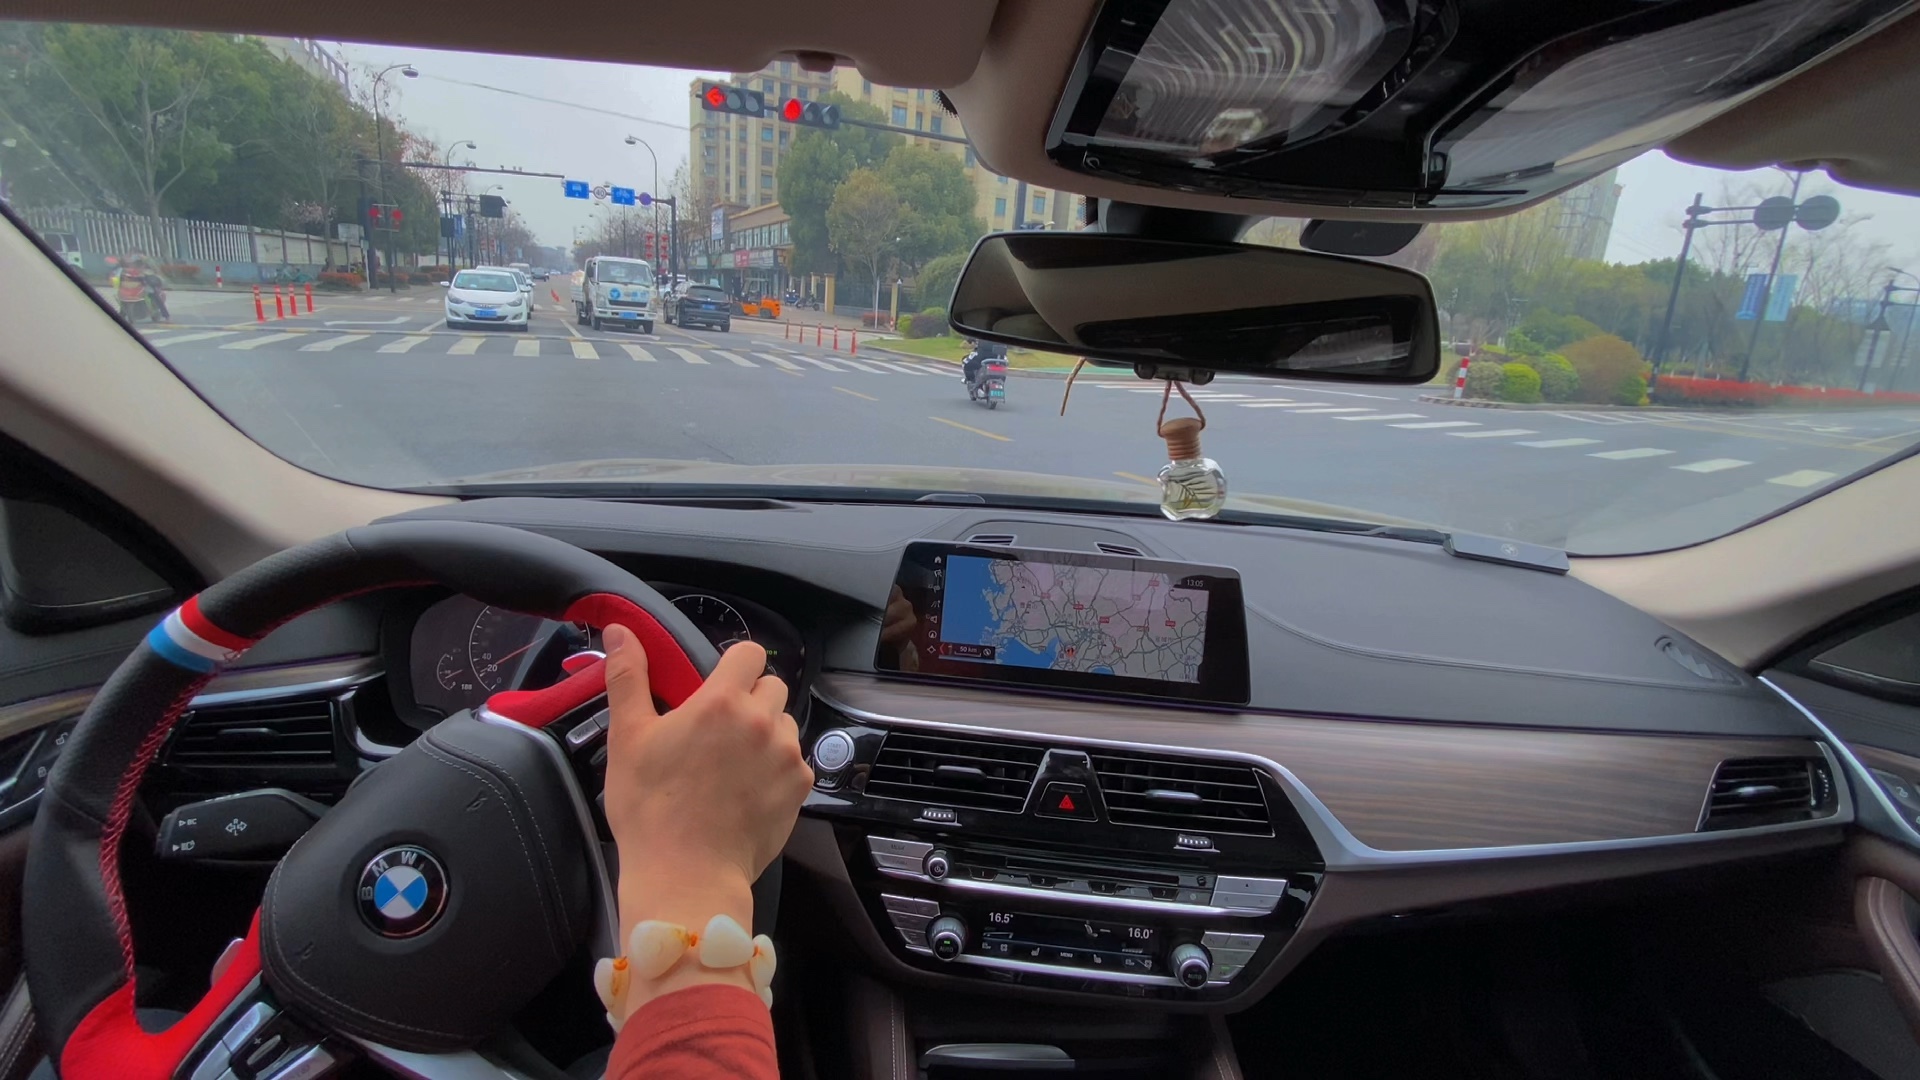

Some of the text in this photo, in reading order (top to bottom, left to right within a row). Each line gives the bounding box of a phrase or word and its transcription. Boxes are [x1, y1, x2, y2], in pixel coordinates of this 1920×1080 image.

[1186, 579, 1204, 588] 13:05
[697, 605, 703, 614] 3
[718, 613, 724, 622] 4
[481, 652, 492, 660] 40
[487, 664, 498, 672] 20
[361, 851, 418, 901] BMW
[1060, 951, 1074, 959] MENU
